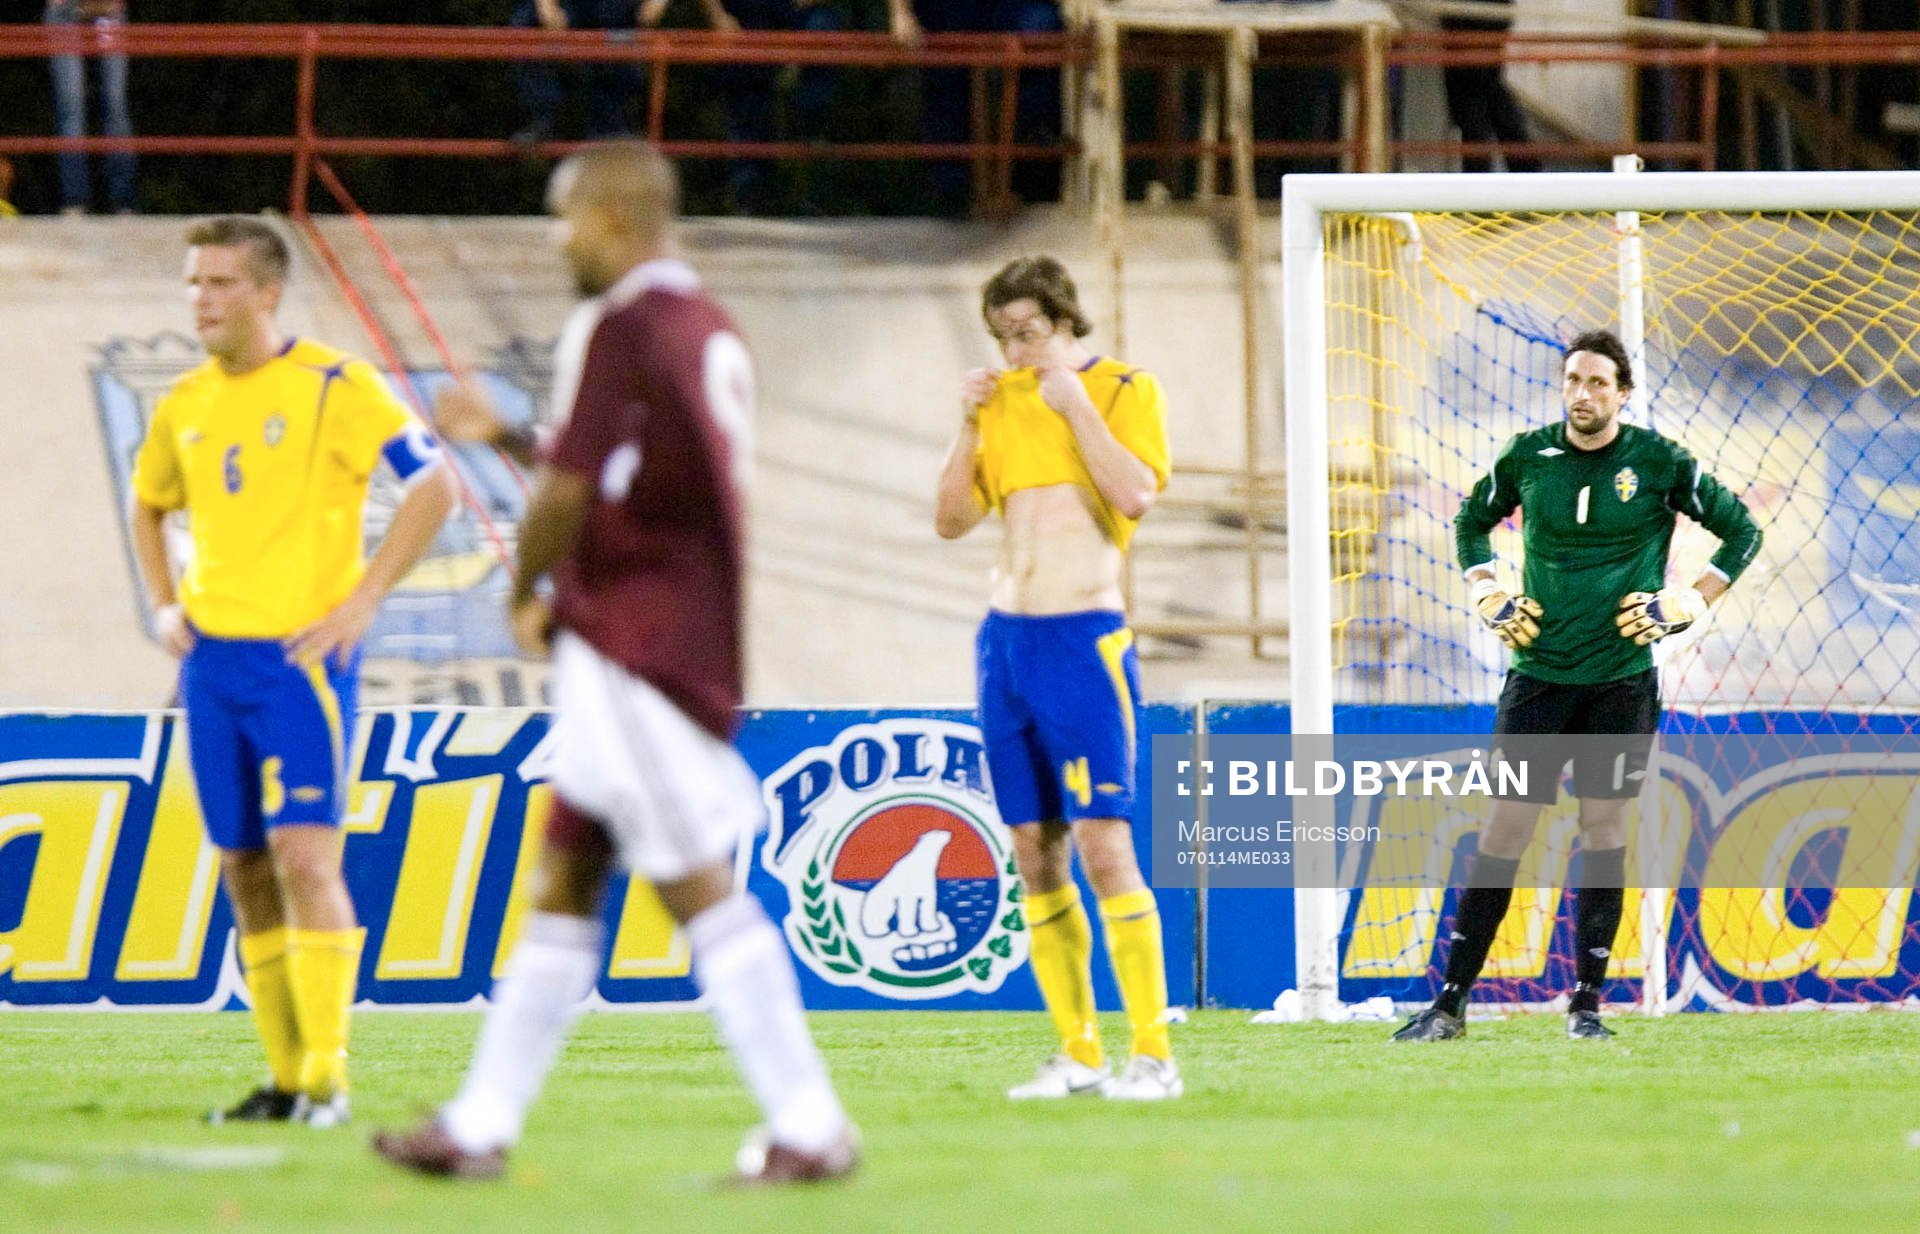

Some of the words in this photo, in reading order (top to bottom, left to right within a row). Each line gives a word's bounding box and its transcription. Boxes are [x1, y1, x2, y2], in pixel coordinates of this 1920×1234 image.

[222, 442, 244, 496] 6
[1576, 485, 1591, 524] 1
[1062, 756, 1092, 807] 4
